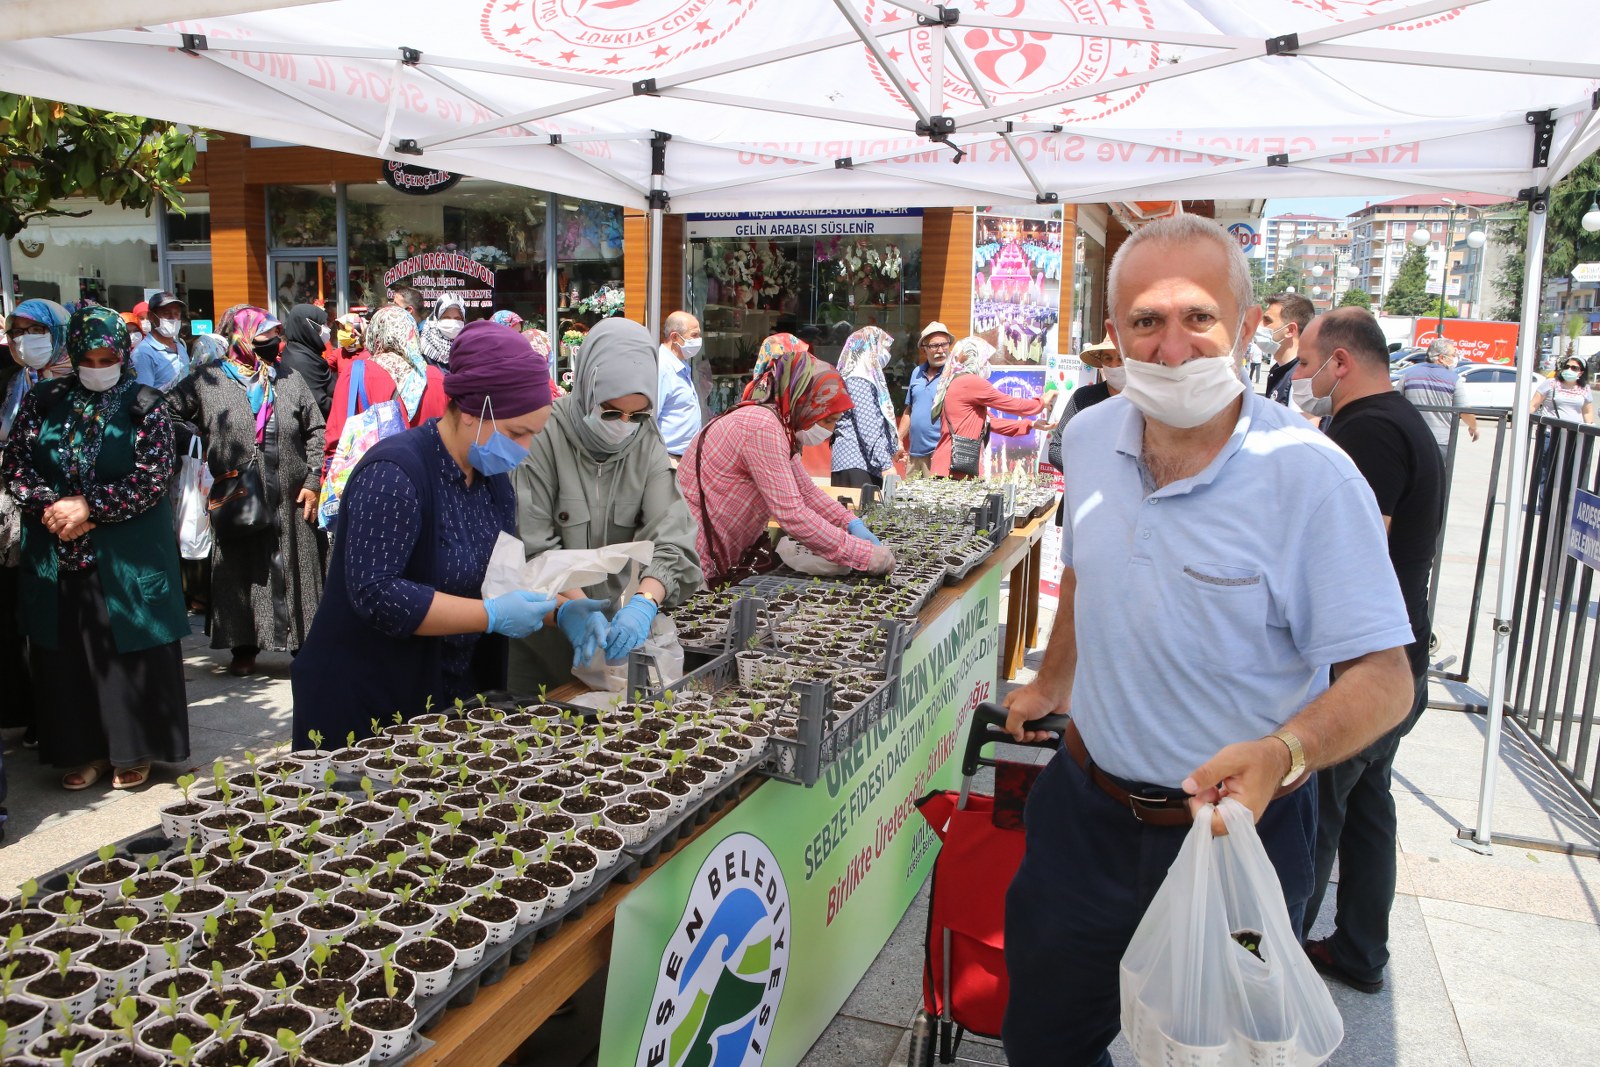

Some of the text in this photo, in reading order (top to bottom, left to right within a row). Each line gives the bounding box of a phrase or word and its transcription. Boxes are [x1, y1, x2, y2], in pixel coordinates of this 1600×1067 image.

[394, 169, 450, 189] ÇİÇEKÇİLİK
[736, 220, 875, 236] GELİN ARABASI SÜSLENİR
[384, 250, 495, 289] CANDAN ORGANİZASYON
[804, 806, 848, 881] SEBZE
[850, 759, 885, 827] FİDESİ
[887, 714, 926, 781] DAĞITIM
[826, 846, 873, 928] Birlikte
[708, 850, 785, 1055] BELEDİYESİ
